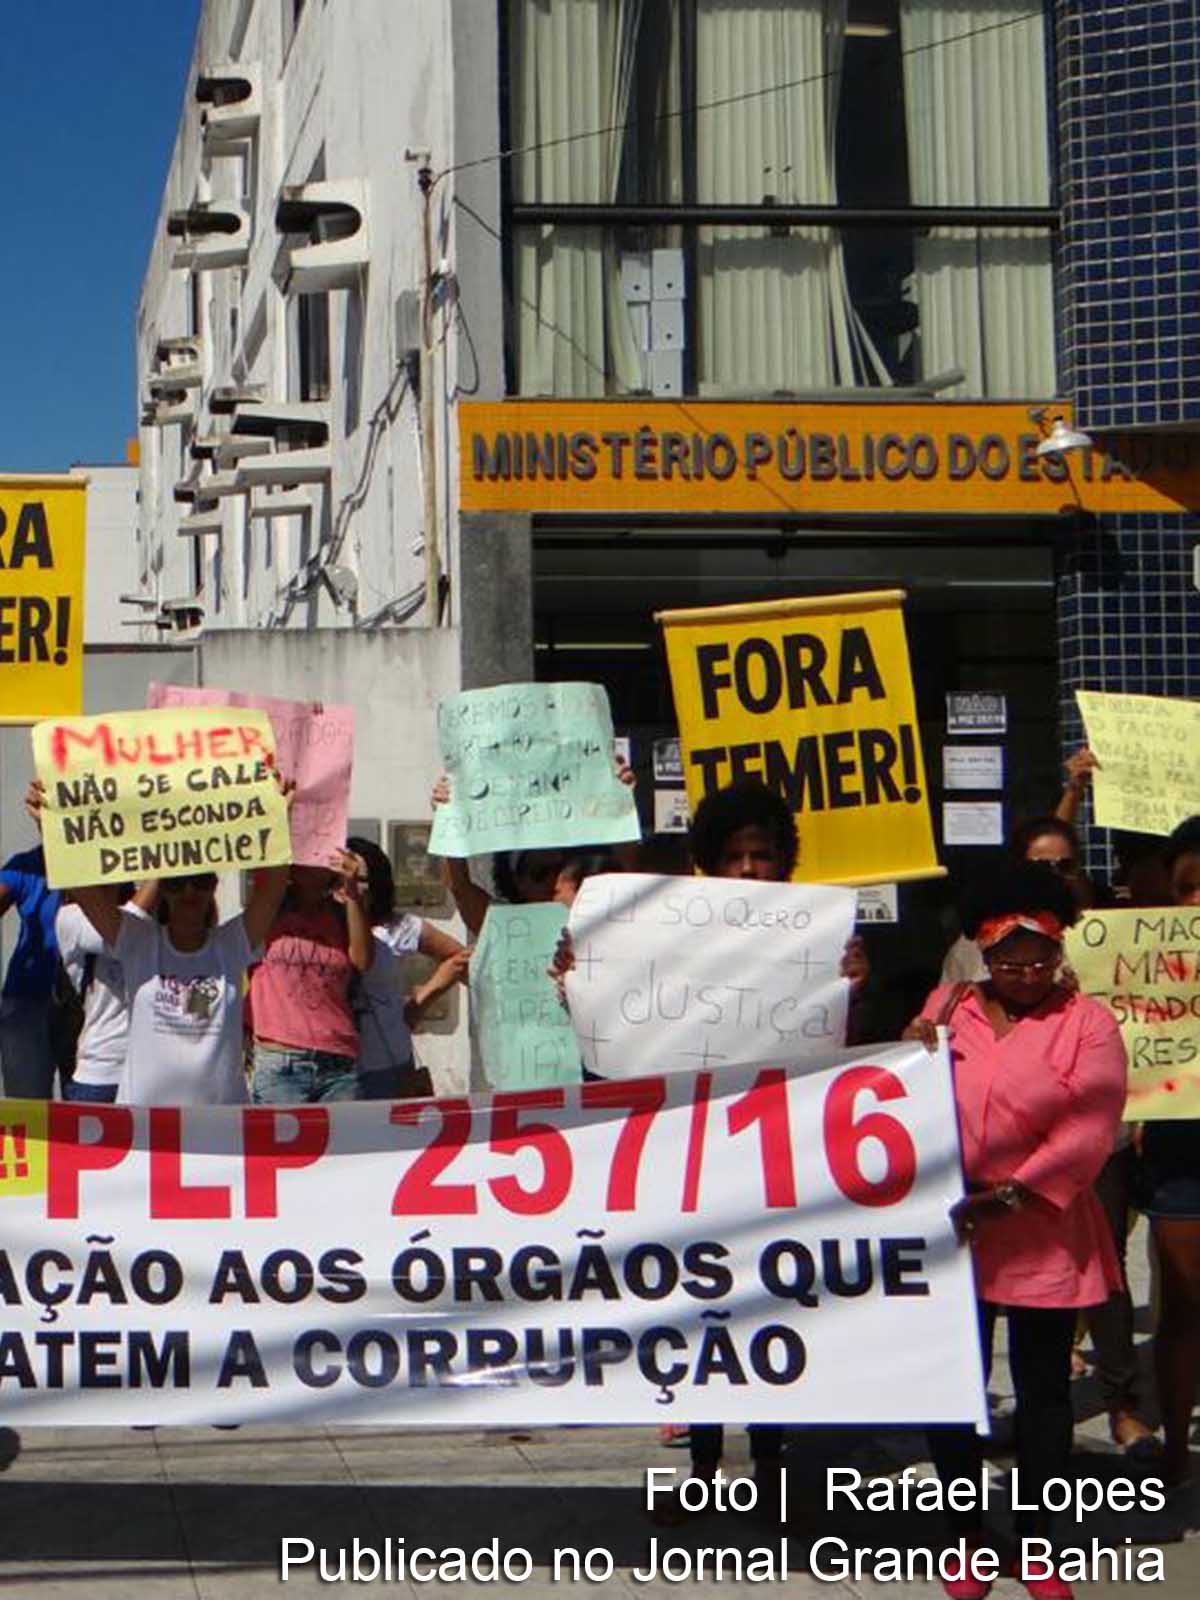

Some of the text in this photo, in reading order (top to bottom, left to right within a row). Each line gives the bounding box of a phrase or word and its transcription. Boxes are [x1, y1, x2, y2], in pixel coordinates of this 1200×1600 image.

[744, 426, 938, 482] PÚBLICO
[947, 433, 1010, 482] DO
[695, 626, 887, 720] FORA
[50, 723, 267, 773] MULHER
[690, 723, 923, 814] TEMER!
[55, 760, 269, 809] NÃO SE CALE
[62, 812, 125, 845] NÃO
[140, 796, 267, 834] ESCONDA
[1082, 918, 1108, 948] O
[1114, 950, 1200, 986] MAT
[46, 1101, 331, 1220] PLP
[388, 1064, 917, 1217] 257/16
[208, 1248, 368, 1305] AOS
[391, 1228, 734, 1303] ÓRGÃOS
[758, 1237, 931, 1308] QUE
[216, 1330, 270, 1388] A
[292, 1308, 807, 1405] CORRUPÇÃO
